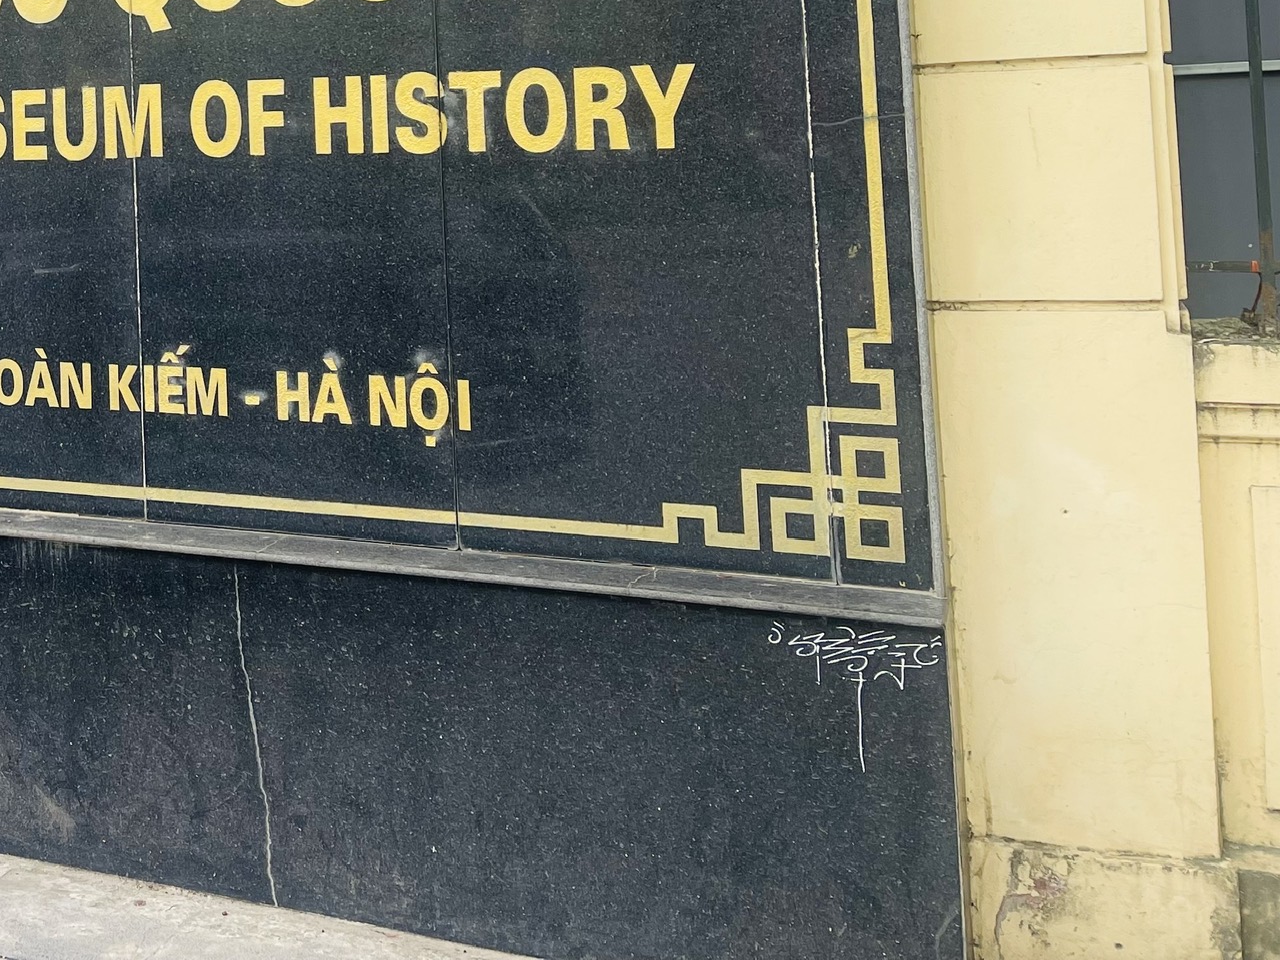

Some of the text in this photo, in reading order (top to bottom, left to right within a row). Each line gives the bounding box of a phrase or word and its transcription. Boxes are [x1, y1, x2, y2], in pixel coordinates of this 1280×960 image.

[190, 78, 284, 158] OF
[314, 64, 695, 154] HISTORY
[108, 345, 229, 417] KIẾM
[245, 394, 260, 406] -
[276, 357, 353, 425] HÀ
[368, 362, 472, 448] NỘI
